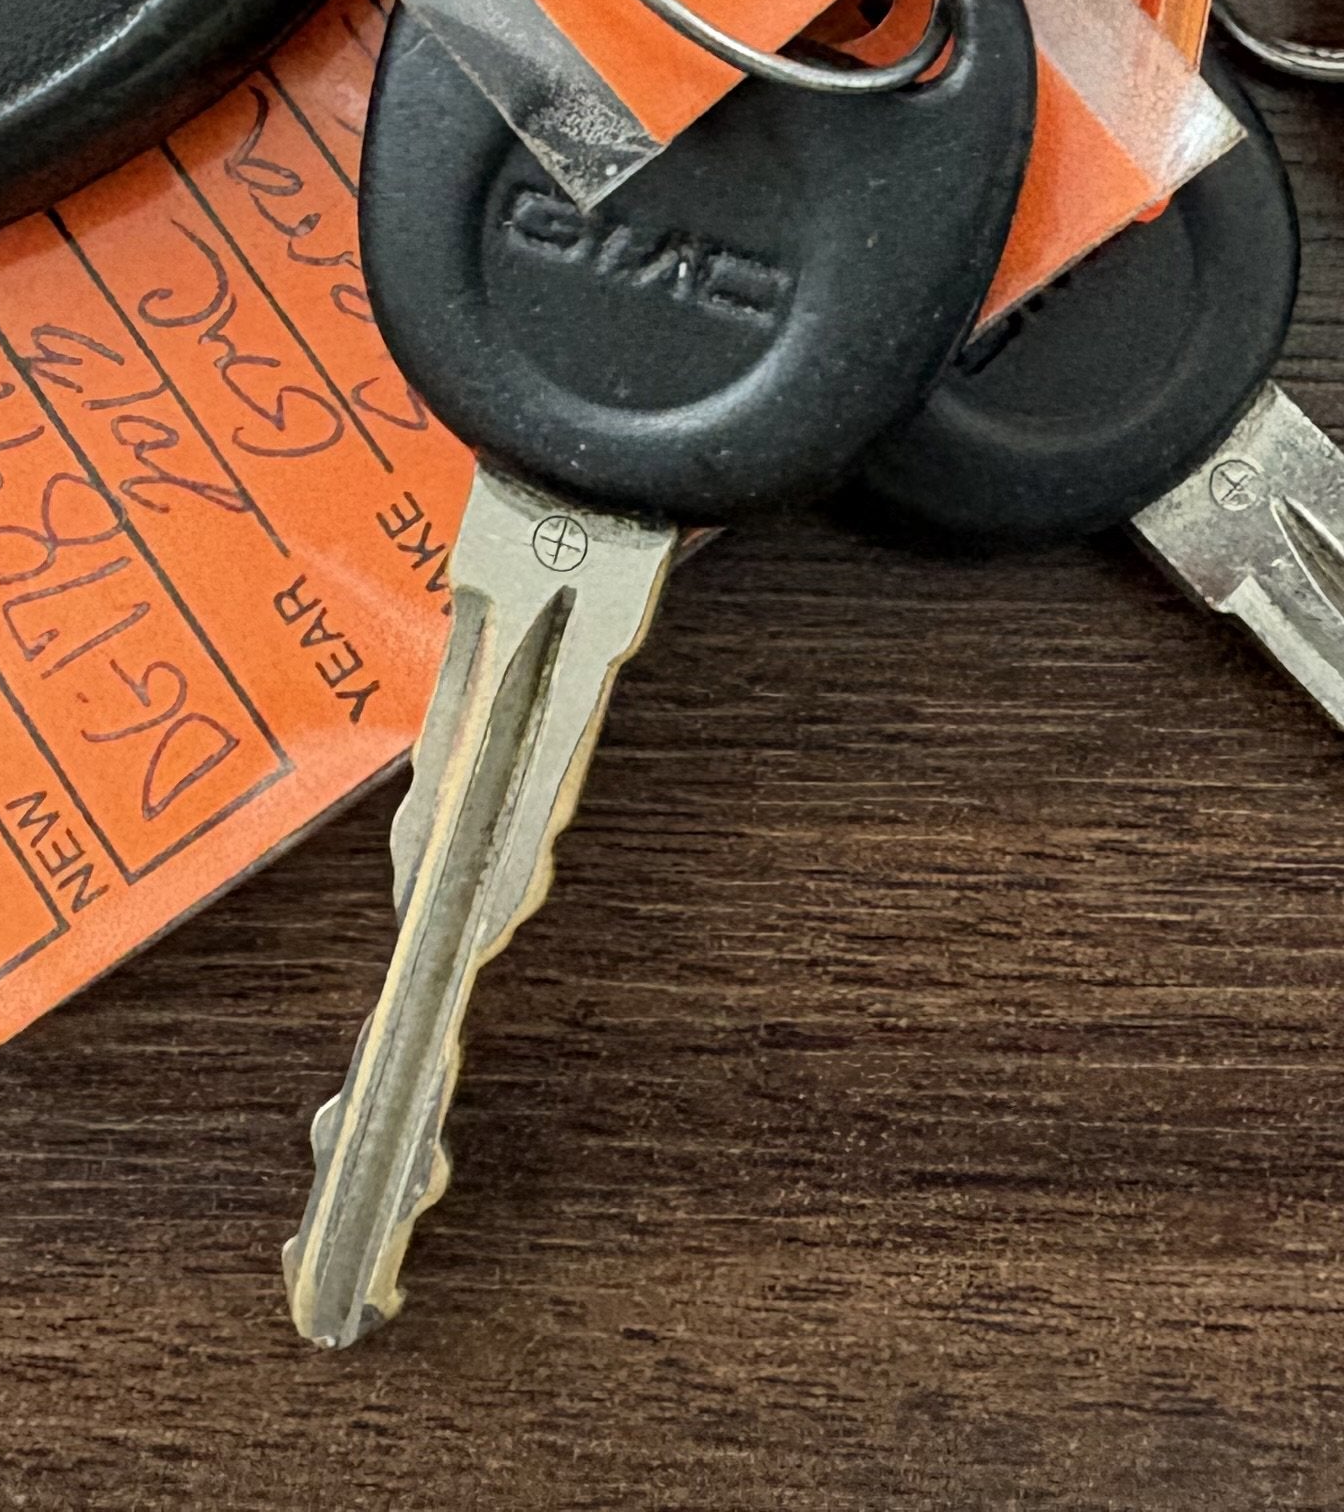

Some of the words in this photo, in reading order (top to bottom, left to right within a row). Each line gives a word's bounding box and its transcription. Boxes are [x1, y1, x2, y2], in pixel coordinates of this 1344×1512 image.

[30, 322, 255, 516] 2013
[376, 490, 454, 616] AKE
[273, 575, 382, 725] YEAR
[9, 789, 111, 913] NEW
